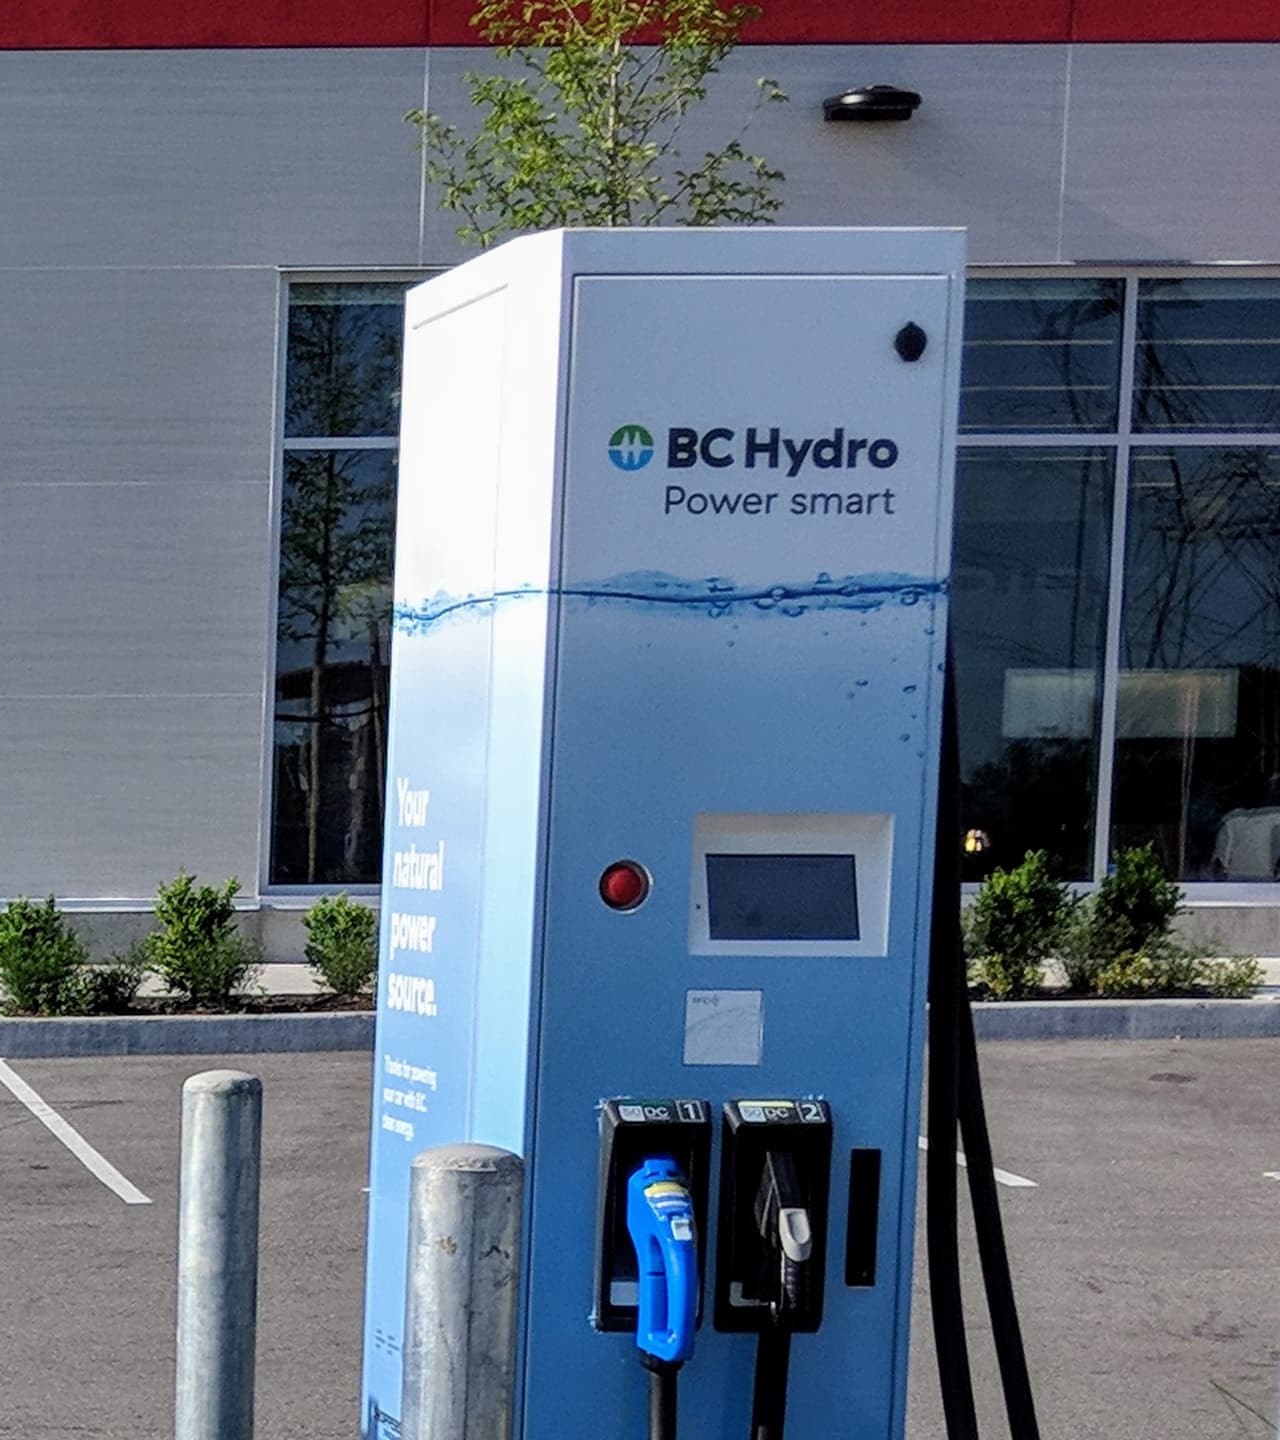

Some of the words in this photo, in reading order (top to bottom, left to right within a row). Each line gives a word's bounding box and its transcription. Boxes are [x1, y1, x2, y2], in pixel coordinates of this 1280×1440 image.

[667, 427, 735, 469] BC
[744, 427, 899, 477] Hydro
[665, 486, 778, 515] Power
[790, 488, 895, 515] smart
[397, 777, 430, 827] Your
[393, 839, 445, 891] natural
[389, 911, 437, 961] power
[386, 972, 438, 1017] source.
[683, 1103, 696, 1120] 1
[802, 1104, 820, 1121] 2
